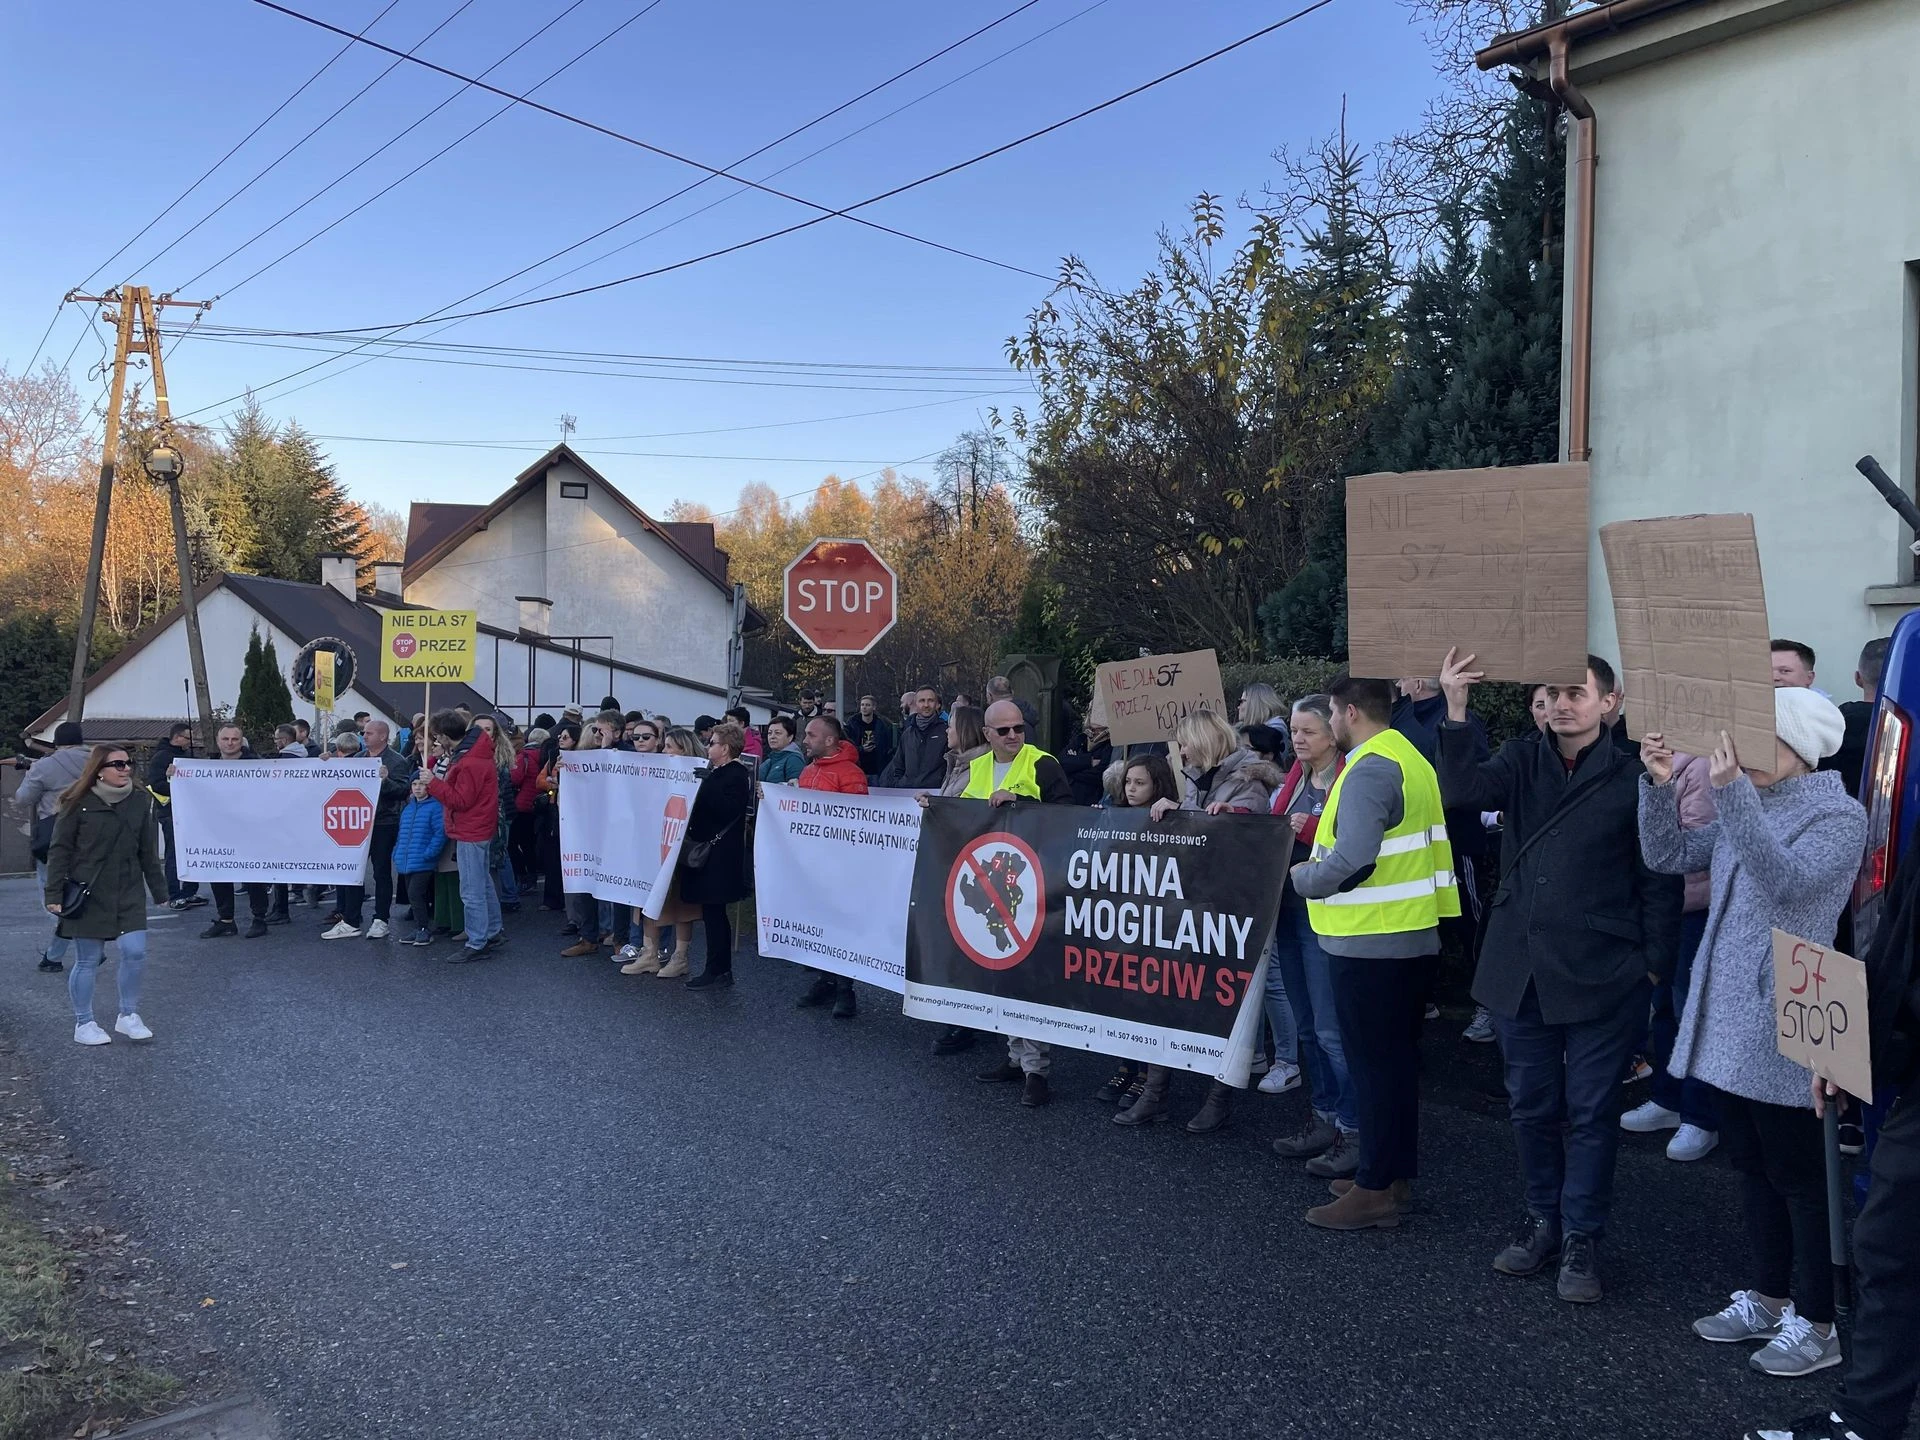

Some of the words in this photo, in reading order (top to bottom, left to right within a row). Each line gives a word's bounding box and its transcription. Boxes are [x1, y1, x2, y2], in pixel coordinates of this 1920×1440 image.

[1369, 493, 1424, 530] NIE
[1460, 489, 1526, 524] DLA
[797, 579, 884, 613] STOP
[392, 615, 414, 627] NIE
[419, 615, 447, 627] DLA
[451, 615, 467, 627] S7
[420, 640, 466, 652] PRZEZ
[394, 662, 462, 678] KRAKÓW
[1108, 670, 1131, 693] NIE
[1133, 668, 1158, 690] DLA
[1111, 694, 1152, 718] PRZEZ
[176, 769, 193, 778] NIE!
[195, 769, 213, 778] DLA
[215, 767, 271, 778] WARIANTÓW
[272, 769, 281, 778] S7
[284, 769, 310, 778] PRZEZ
[312, 769, 376, 781] WRZĄSOWICE
[565, 763, 580, 773] NIE!
[583, 763, 600, 773] DLA
[649, 767, 665, 778] PRZEZ
[327, 807, 371, 830] STOP
[778, 799, 800, 813] NIE!
[802, 801, 821, 816] DLA
[823, 805, 886, 824] WSZYSTKICH
[790, 822, 820, 837] PRZEZ
[823, 826, 857, 846] GMINĘ
[1077, 827, 1110, 841] Kolejna
[1111, 829, 1137, 841] trasa
[1140, 831, 1207, 847] ekspresowa?
[202, 847, 235, 855] HAŁASU!
[563, 853, 581, 862] NIE!
[583, 853, 595, 862] DLA
[200, 860, 260, 870] ZWIĘKSZONEGO
[262, 862, 335, 870] ZANIECZYSZCZENIA
[336, 862, 357, 871] POWI
[564, 868, 582, 877] NIE!
[1067, 850, 1184, 899] GMINA
[1006, 875, 1016, 884] S7
[773, 918, 790, 930] DLA
[792, 922, 824, 938] HAŁASU!
[1064, 896, 1253, 960] MOGILANY
[771, 933, 790, 945] DLA
[791, 936, 847, 960] ZWIĘKSZONEGO
[1064, 945, 1206, 1000] PRZECIW
[1215, 967, 1253, 1007] S7
[909, 995, 993, 1014] www.mogilanyprzeciws7.pl
[1003, 1009, 1096, 1034] kontakt@mogilanyprzeciws7.pl
[1106, 1029, 1117, 1038] tel.
[1118, 1031, 1130, 1041] 507
[1131, 1034, 1143, 1044] 490
[1144, 1037, 1157, 1046] 310
[1181, 1044, 1206, 1055] GMINA
[1781, 1000, 1848, 1051] STOP
